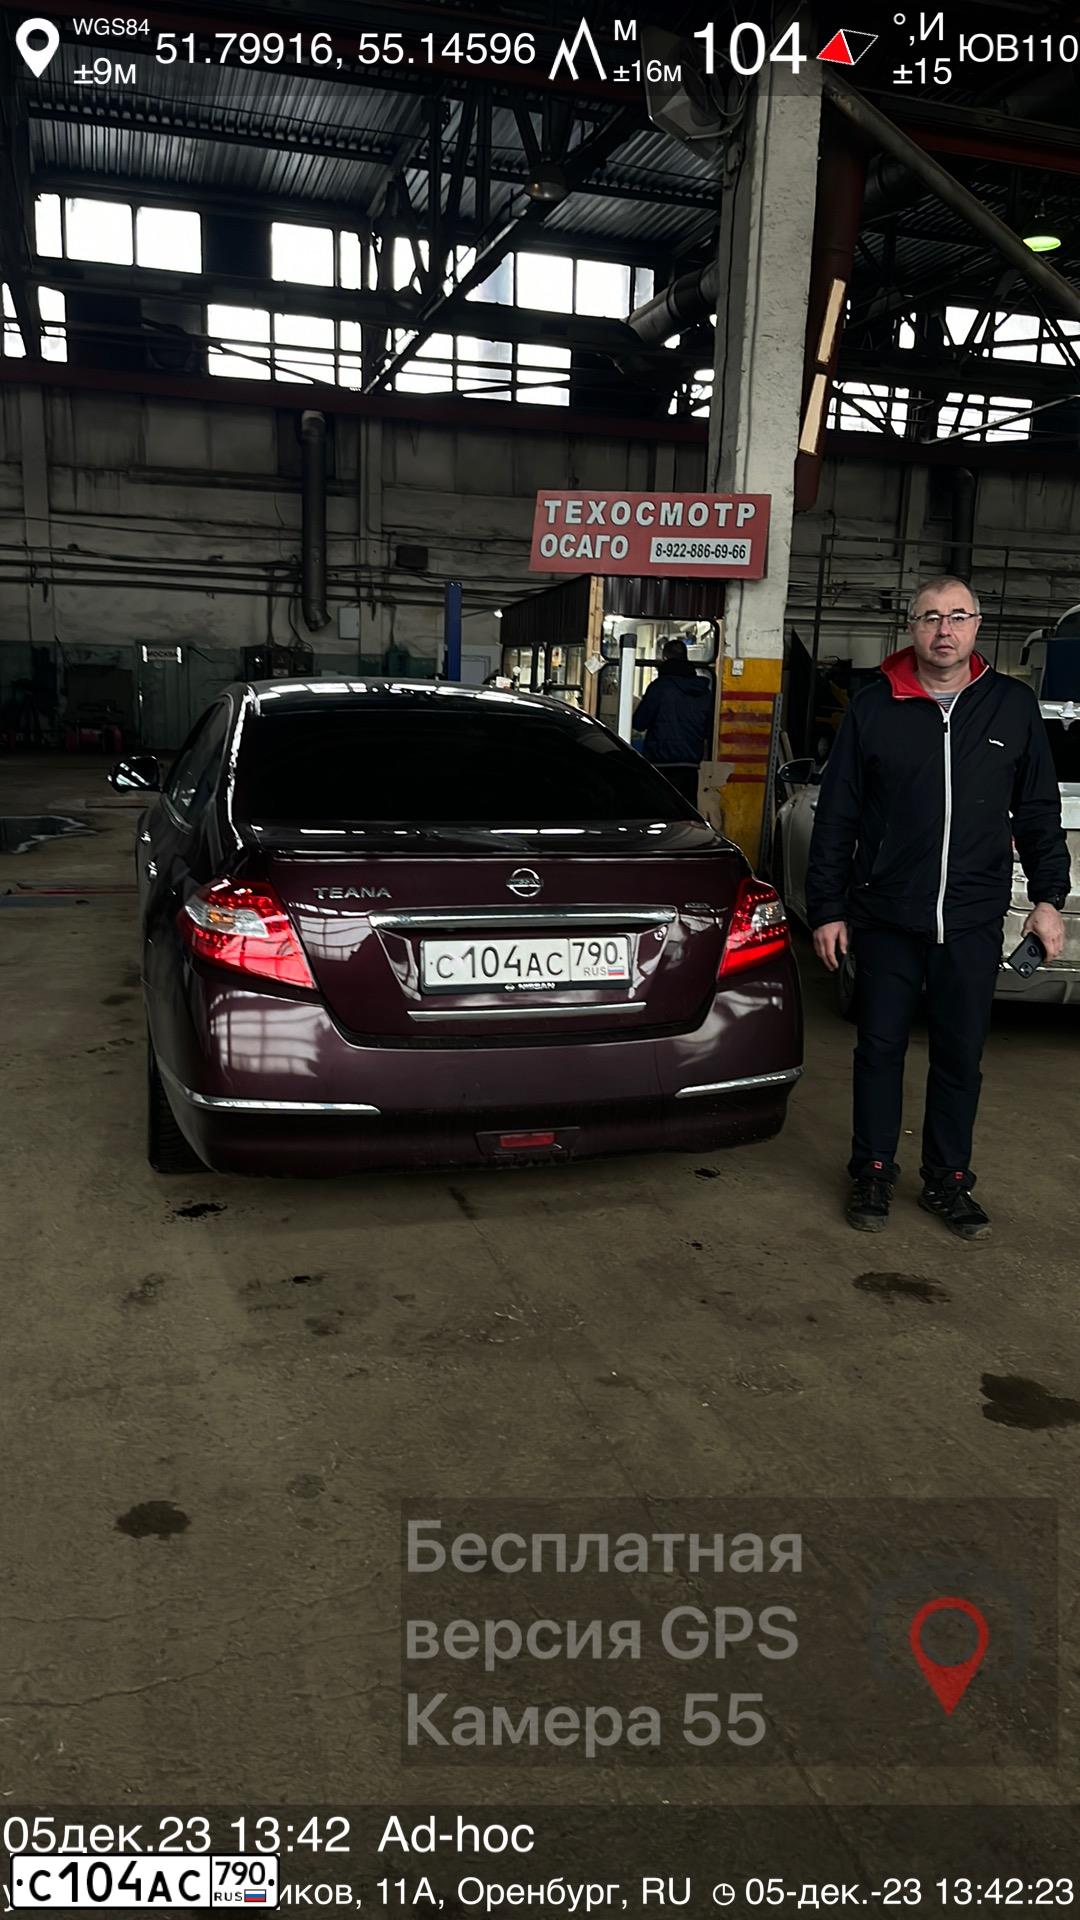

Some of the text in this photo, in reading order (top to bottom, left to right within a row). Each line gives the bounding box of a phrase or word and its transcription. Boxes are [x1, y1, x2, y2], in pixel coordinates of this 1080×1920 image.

[544, 499, 756, 528] ТЕХОСМОТР
[540, 533, 629, 560] ОСАГО
[655, 543, 747, 560] 8-922-886-69-66
[313, 887, 392, 900] TEANA
[572, 942, 618, 967] 790
[583, 966, 607, 977] RUS
